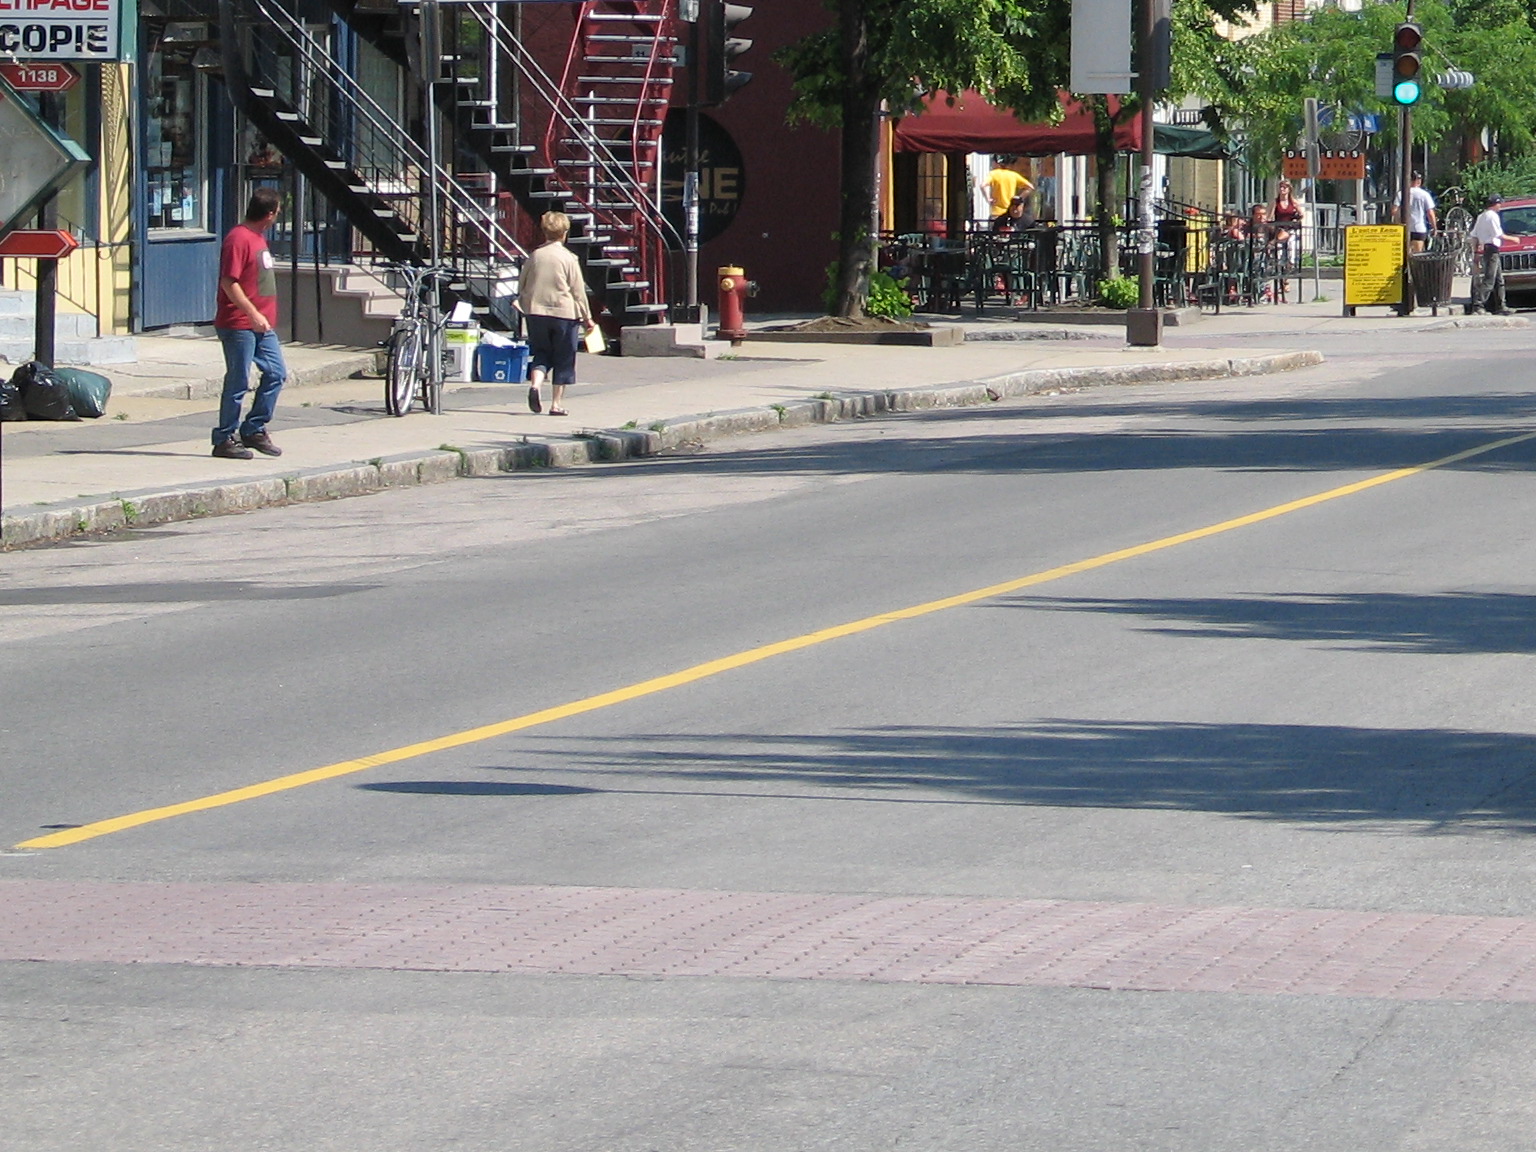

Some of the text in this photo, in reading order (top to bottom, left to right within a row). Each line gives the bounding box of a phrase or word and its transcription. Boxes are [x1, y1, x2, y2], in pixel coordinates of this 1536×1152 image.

[0, 24, 108, 53] COPIE
[18, 69, 58, 83] 1138
[1287, 150, 1358, 158] DEERS
